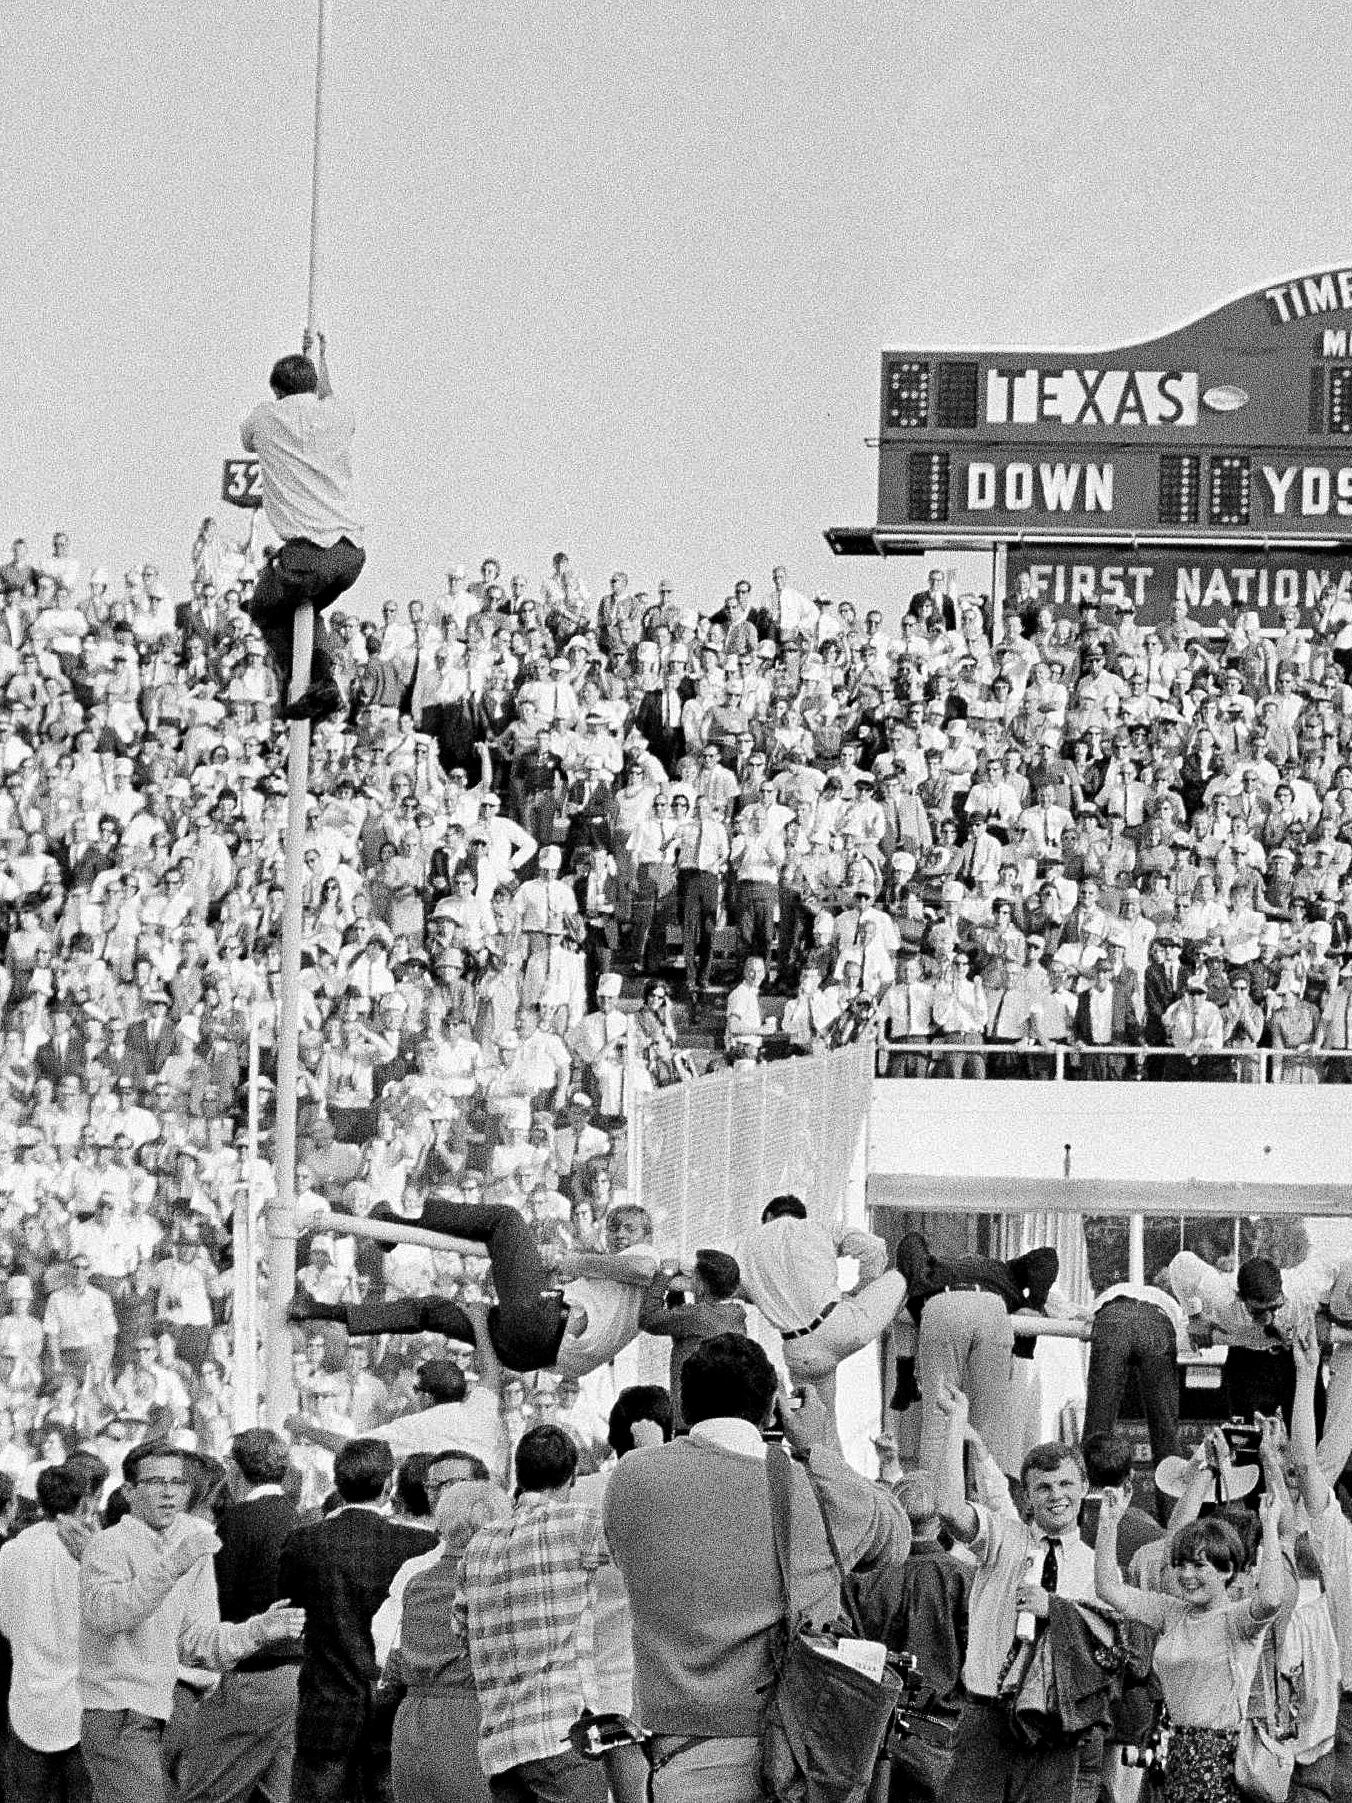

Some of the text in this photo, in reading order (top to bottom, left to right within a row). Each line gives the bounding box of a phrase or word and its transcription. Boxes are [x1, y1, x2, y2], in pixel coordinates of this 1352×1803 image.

[889, 362, 930, 427] 9
[995, 369, 1186, 426] TEXAS
[967, 461, 1114, 512] DOWN
[1178, 456, 1250, 524] 10
[1028, 565, 1153, 606] FIRST
